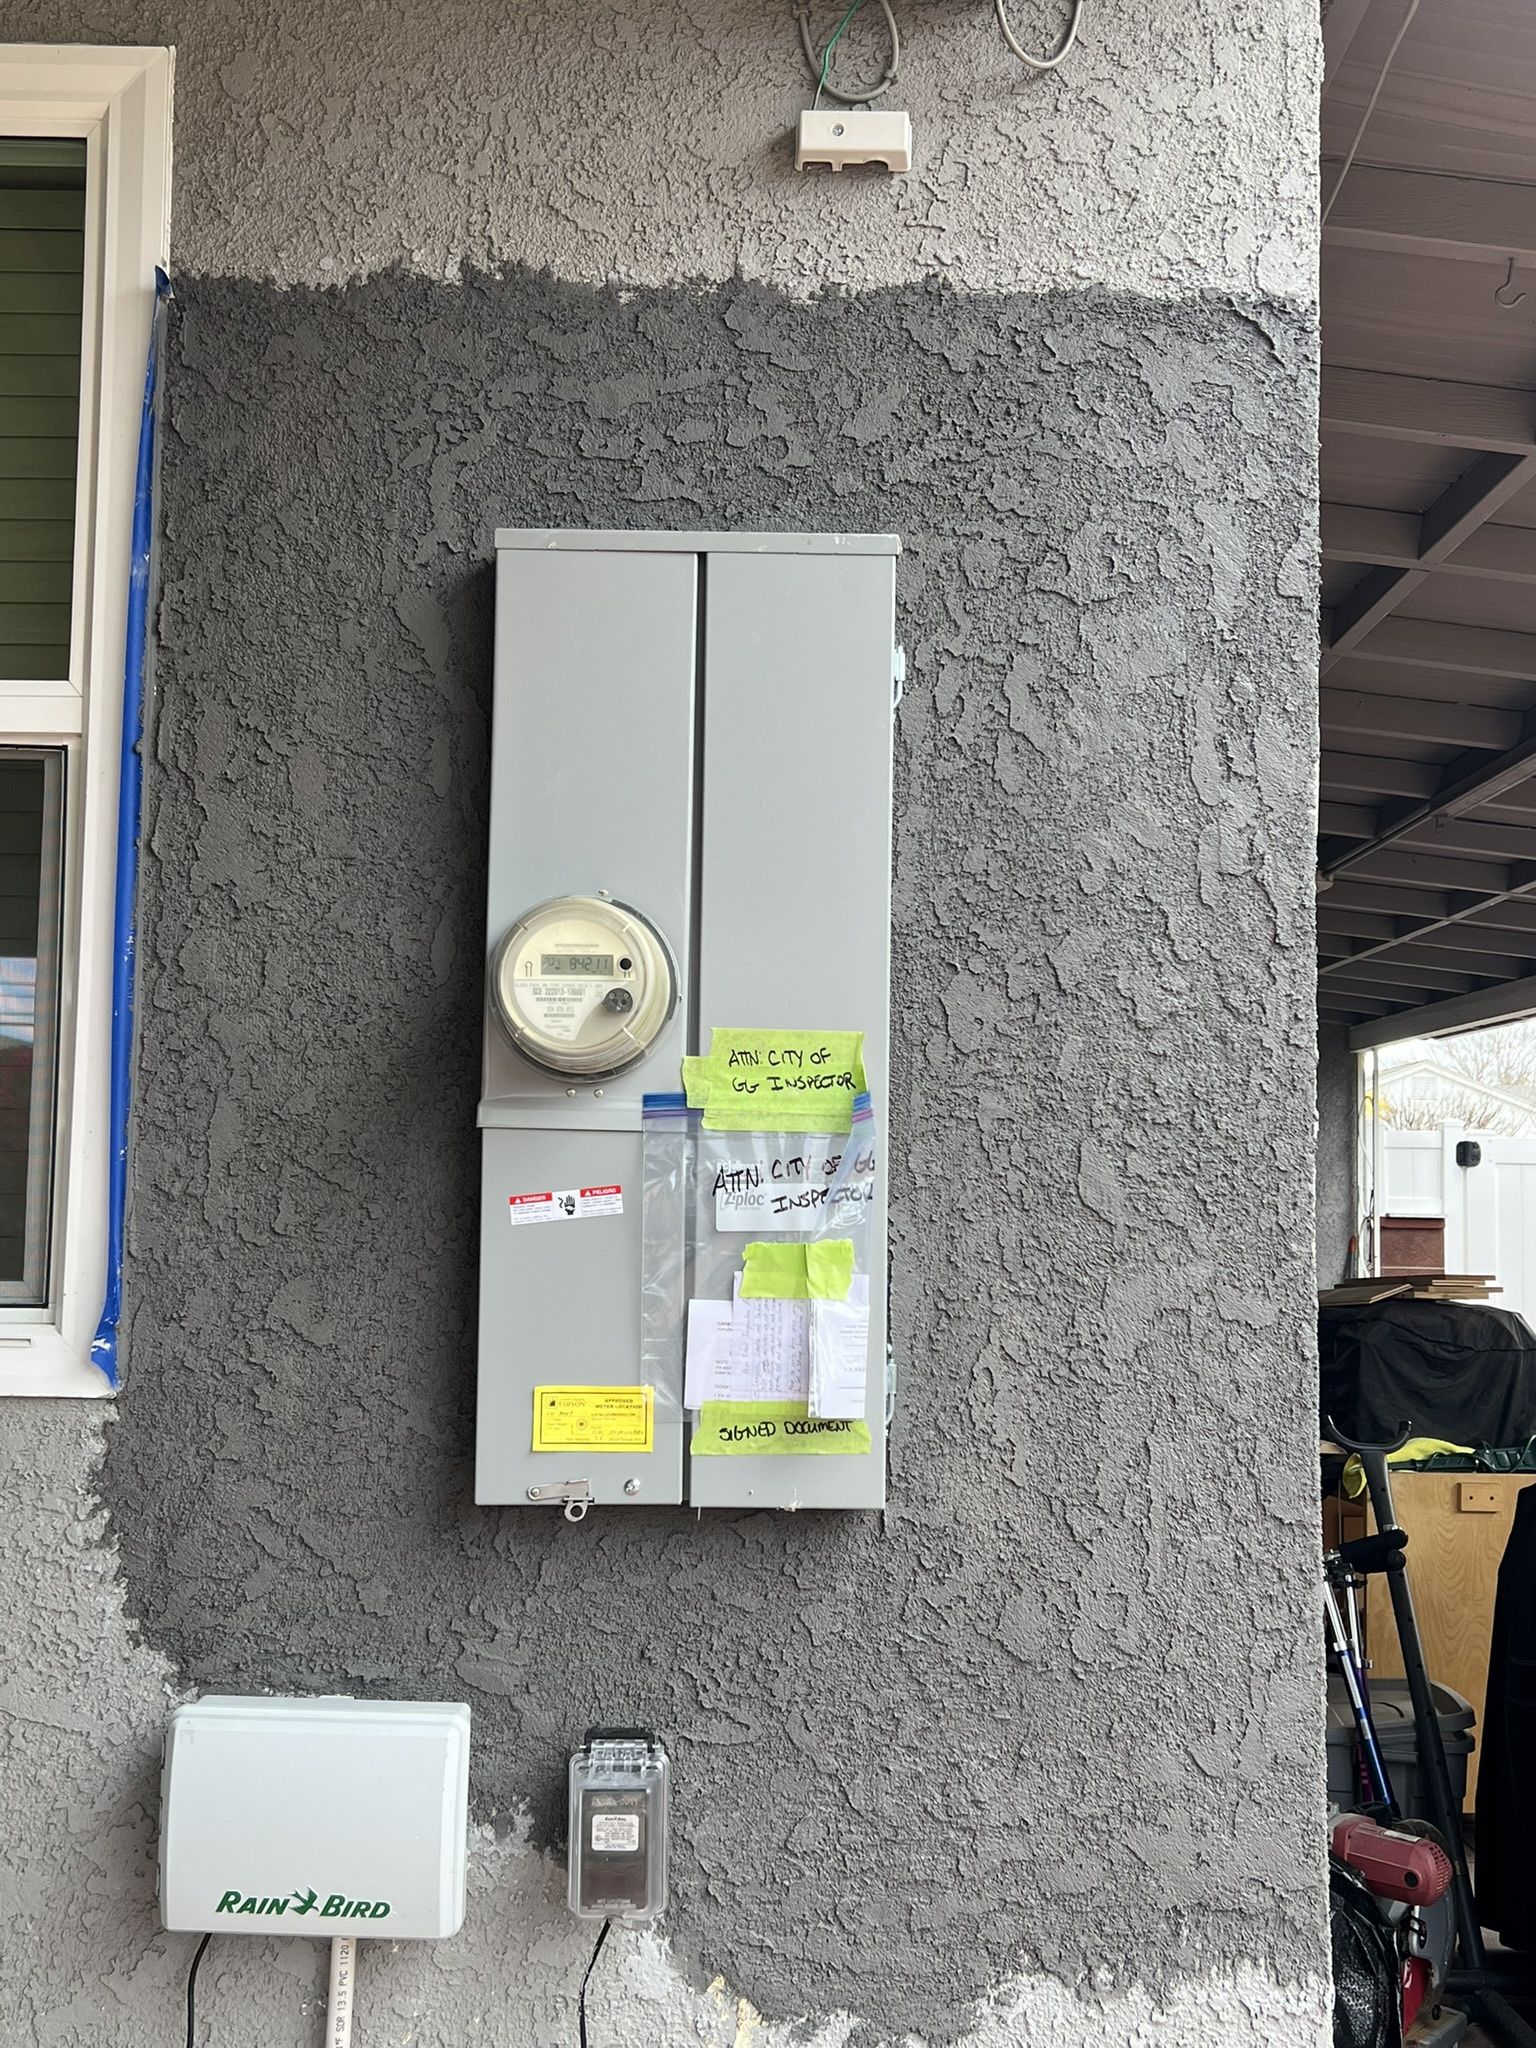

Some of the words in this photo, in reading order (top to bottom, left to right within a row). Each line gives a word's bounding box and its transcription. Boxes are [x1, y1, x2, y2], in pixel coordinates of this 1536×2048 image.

[768, 1050, 803, 1068] CITY
[810, 1047, 831, 1065] OF
[732, 1077, 759, 1093] GG
[767, 1072, 857, 1092] INSPECTOR
[771, 1155, 812, 1181] CITY
[821, 1154, 842, 1176] OF
[724, 1191, 765, 1210] Ziploc
[719, 1421, 776, 1442] SIGNED
[784, 1420, 852, 1435] DOCUMENT
[340, 1944, 350, 1965] 1120
[339, 1970, 349, 1988] PVC
[337, 1989, 347, 2011] 13.5
